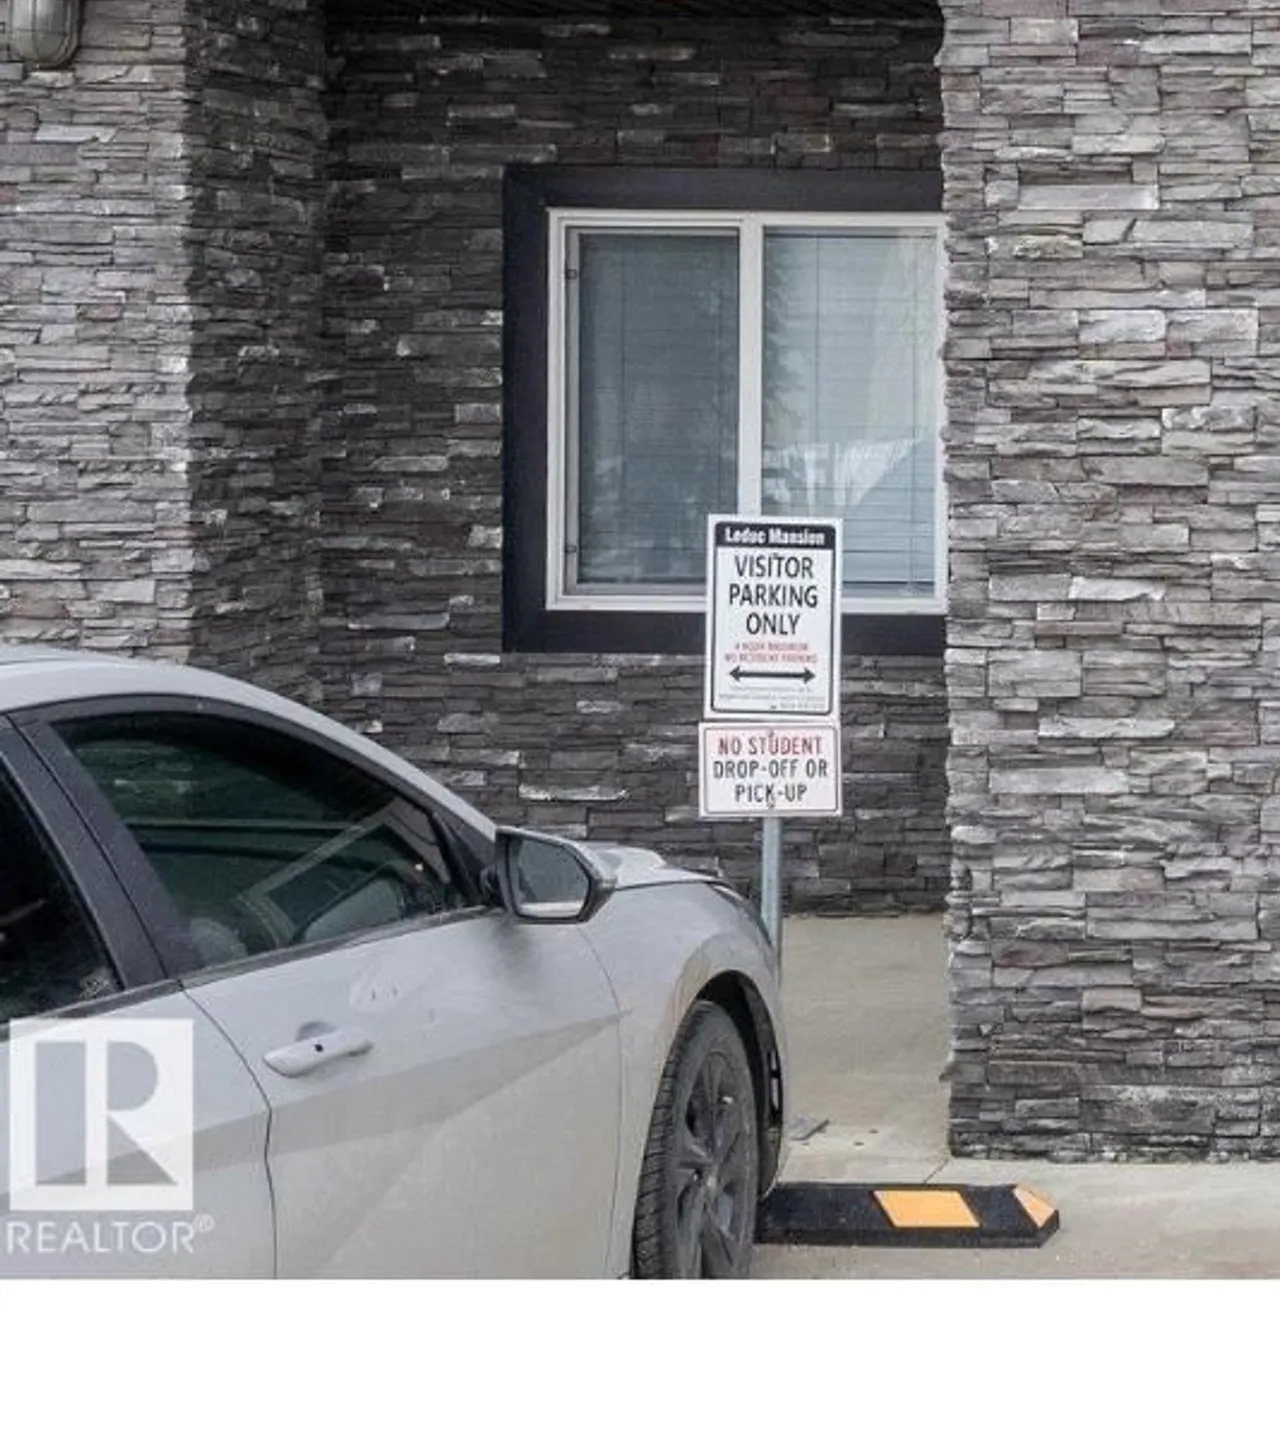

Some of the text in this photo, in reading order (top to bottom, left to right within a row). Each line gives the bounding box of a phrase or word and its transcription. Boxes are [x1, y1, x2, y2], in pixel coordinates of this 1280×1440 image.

[724, 526, 825, 546] Leduc Mansion
[734, 554, 814, 578] VISITOR
[729, 583, 818, 608] PARKING
[746, 611, 801, 635] ONLY
[718, 736, 822, 755] NO STUDENT
[713, 759, 828, 779] DROP-OFF OR
[735, 783, 808, 803] PICK-UP
